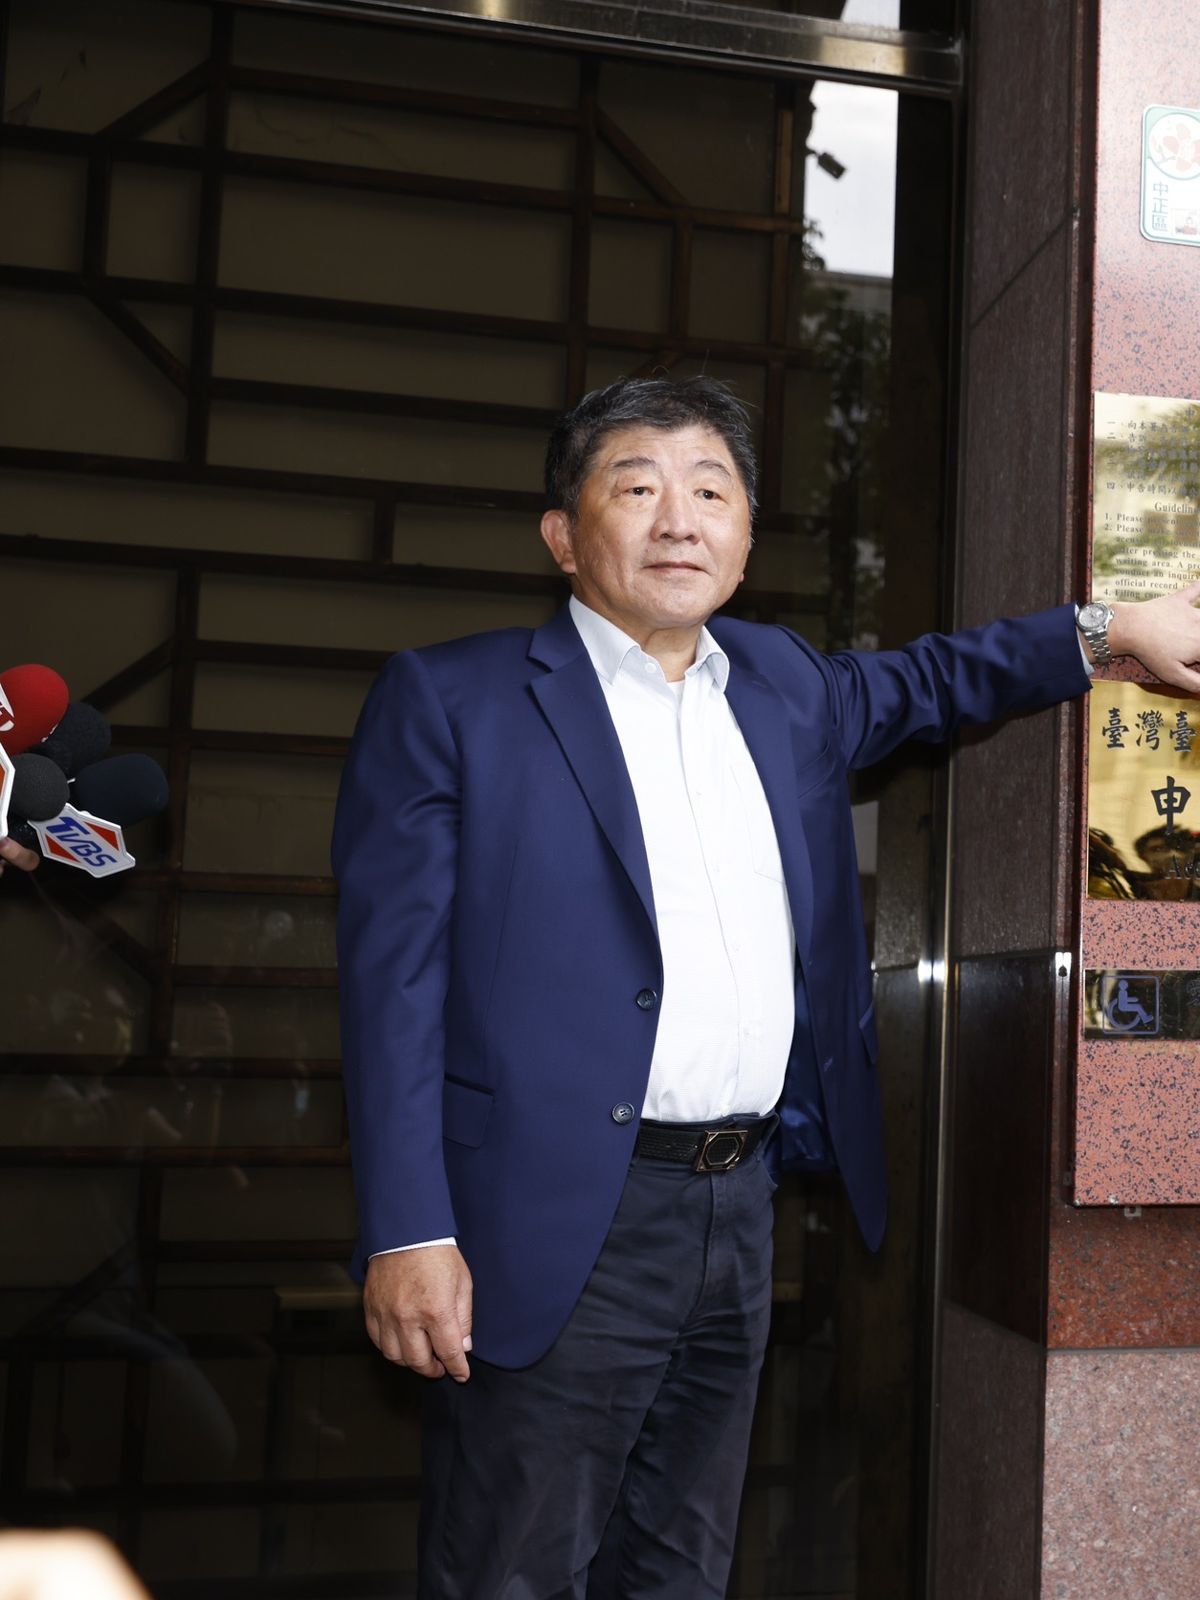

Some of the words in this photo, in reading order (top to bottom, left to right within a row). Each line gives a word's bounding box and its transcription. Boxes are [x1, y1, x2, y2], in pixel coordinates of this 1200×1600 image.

[1152, 181, 1169, 231] 中正區
[1116, 513, 1144, 523] Please
[1104, 523, 1113, 532] 2.
[1116, 524, 1144, 534] Please
[1183, 550, 1196, 560] the
[1152, 560, 1174, 568] area.
[1178, 561, 1184, 569] A
[1168, 570, 1200, 581] inquiry
[1115, 579, 1146, 588] official
[1150, 582, 1178, 590] record
[1104, 588, 1112, 597] 4.
[46, 816, 118, 867] TVBS
